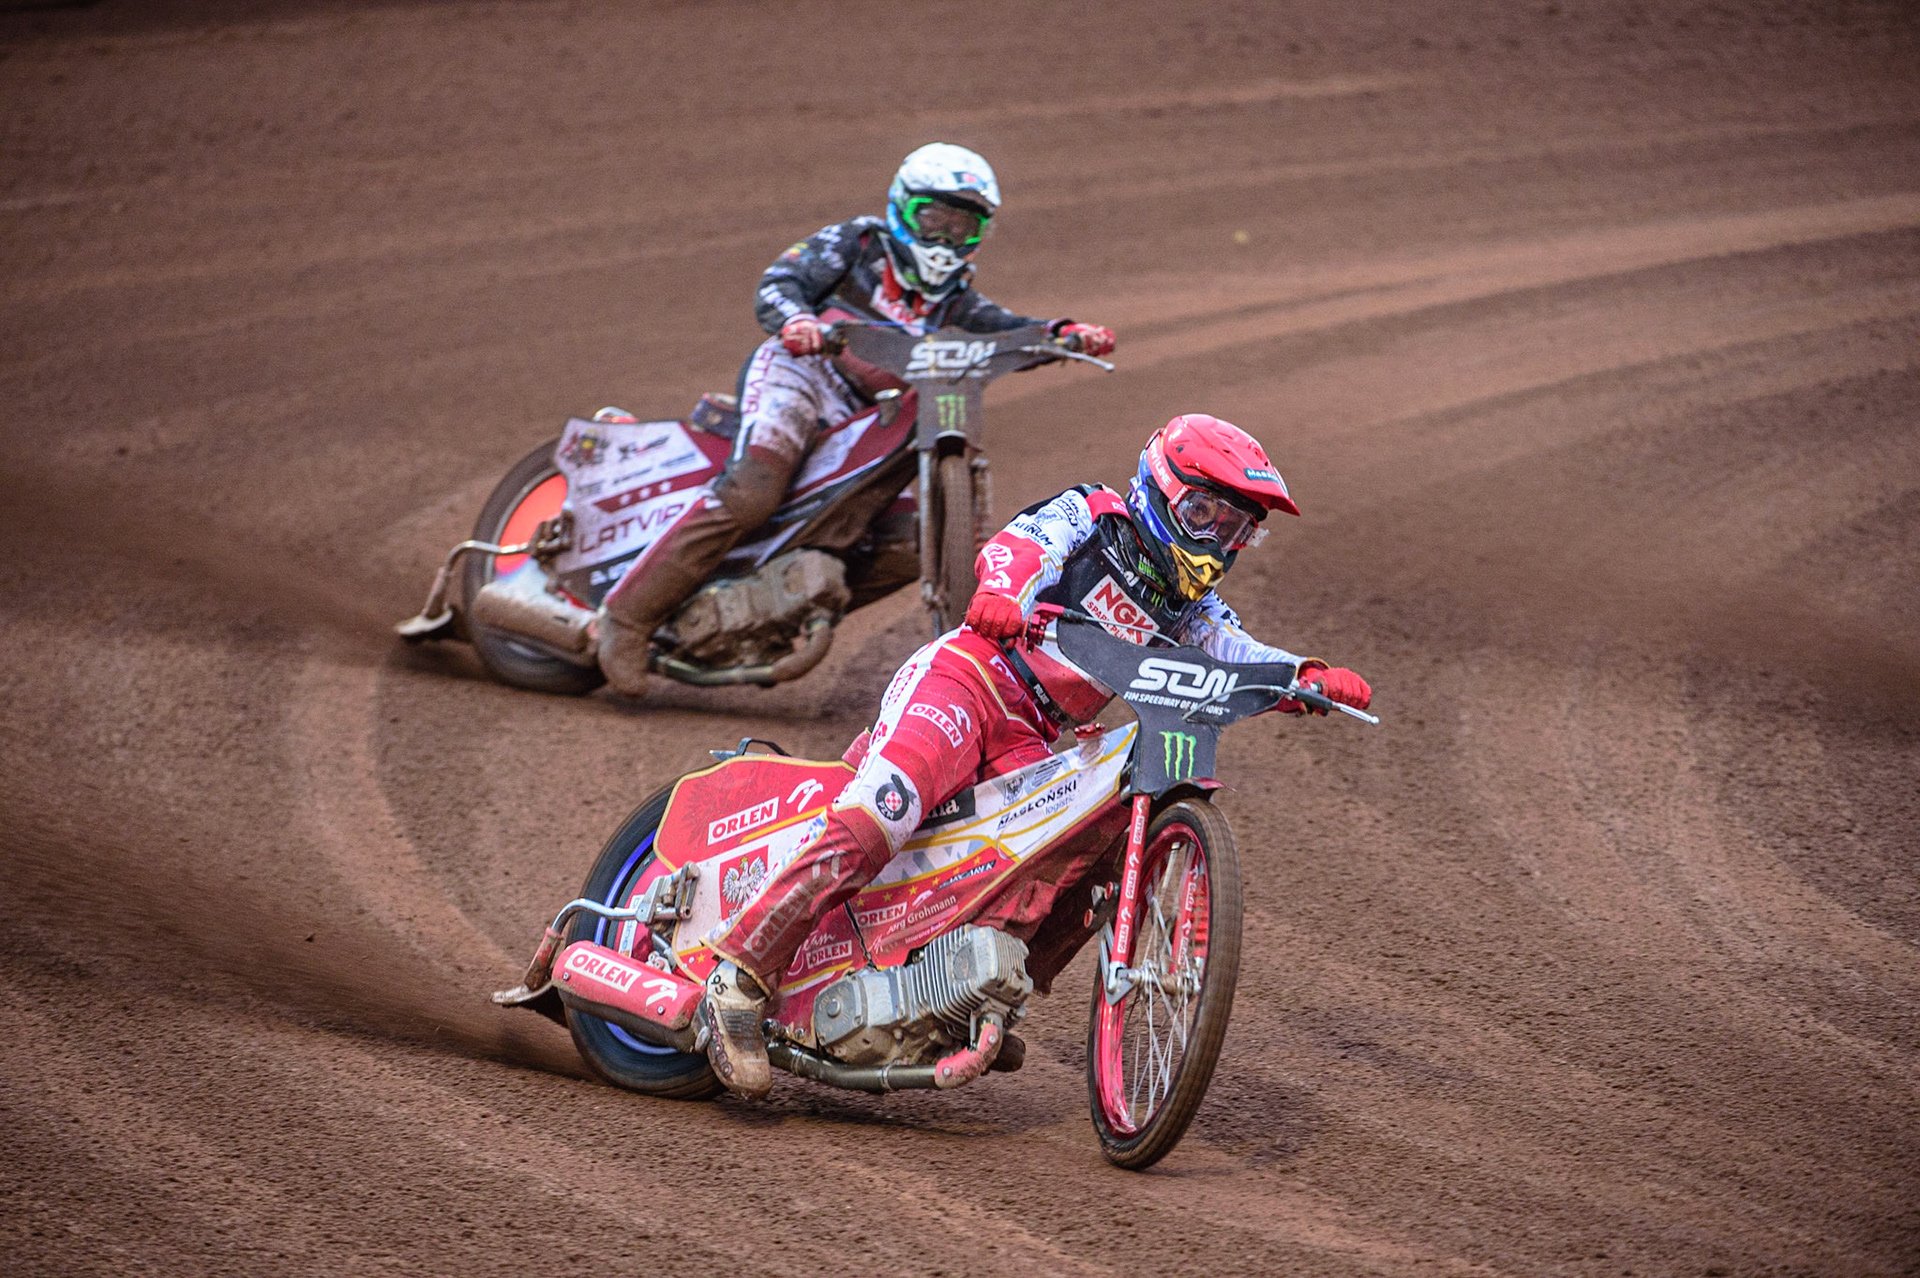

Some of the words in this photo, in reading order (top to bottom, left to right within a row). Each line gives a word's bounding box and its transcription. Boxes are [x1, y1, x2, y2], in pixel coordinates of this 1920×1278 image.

[1094, 581, 1154, 644] NGK
[1123, 691, 1139, 702] FIM
[1139, 694, 1181, 708] SPEEDWAY
[1180, 699, 1191, 710] OF
[912, 705, 961, 741] ORLEN
[711, 802, 775, 838] ORLEN
[877, 801, 895, 820] PZM
[858, 905, 904, 926] ORLEN
[907, 895, 957, 924] Grohmann
[810, 943, 849, 964] ORLEN
[572, 953, 633, 988] ORLEN
[711, 974, 728, 996] 95
